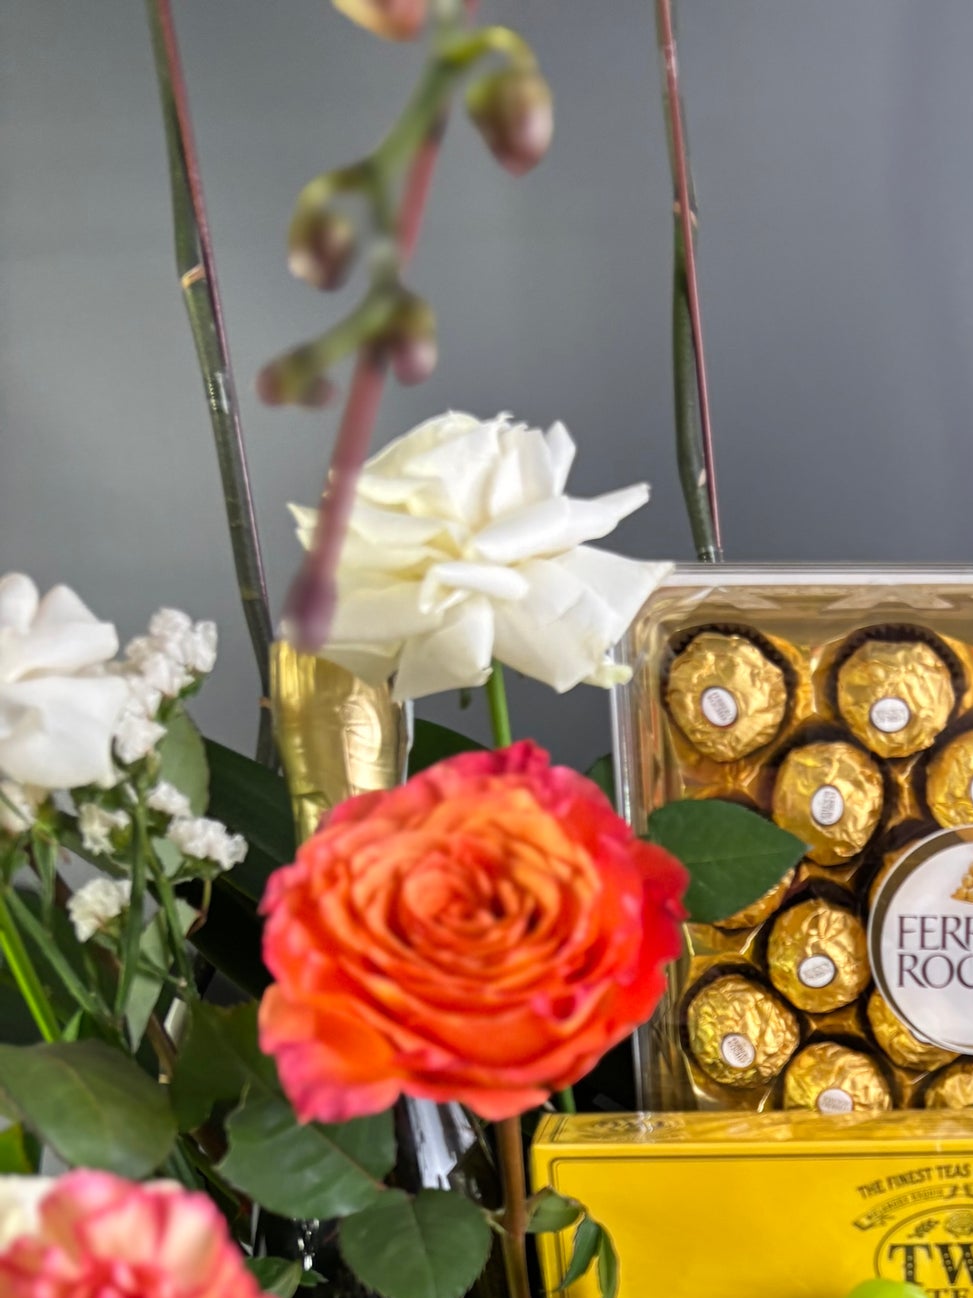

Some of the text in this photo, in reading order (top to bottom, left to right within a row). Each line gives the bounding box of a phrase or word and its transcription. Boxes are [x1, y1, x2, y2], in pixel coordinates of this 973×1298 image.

[856, 1177, 886, 1200] THE
[886, 1166, 932, 1191] FINEST
[935, 1162, 971, 1181] TEAS
